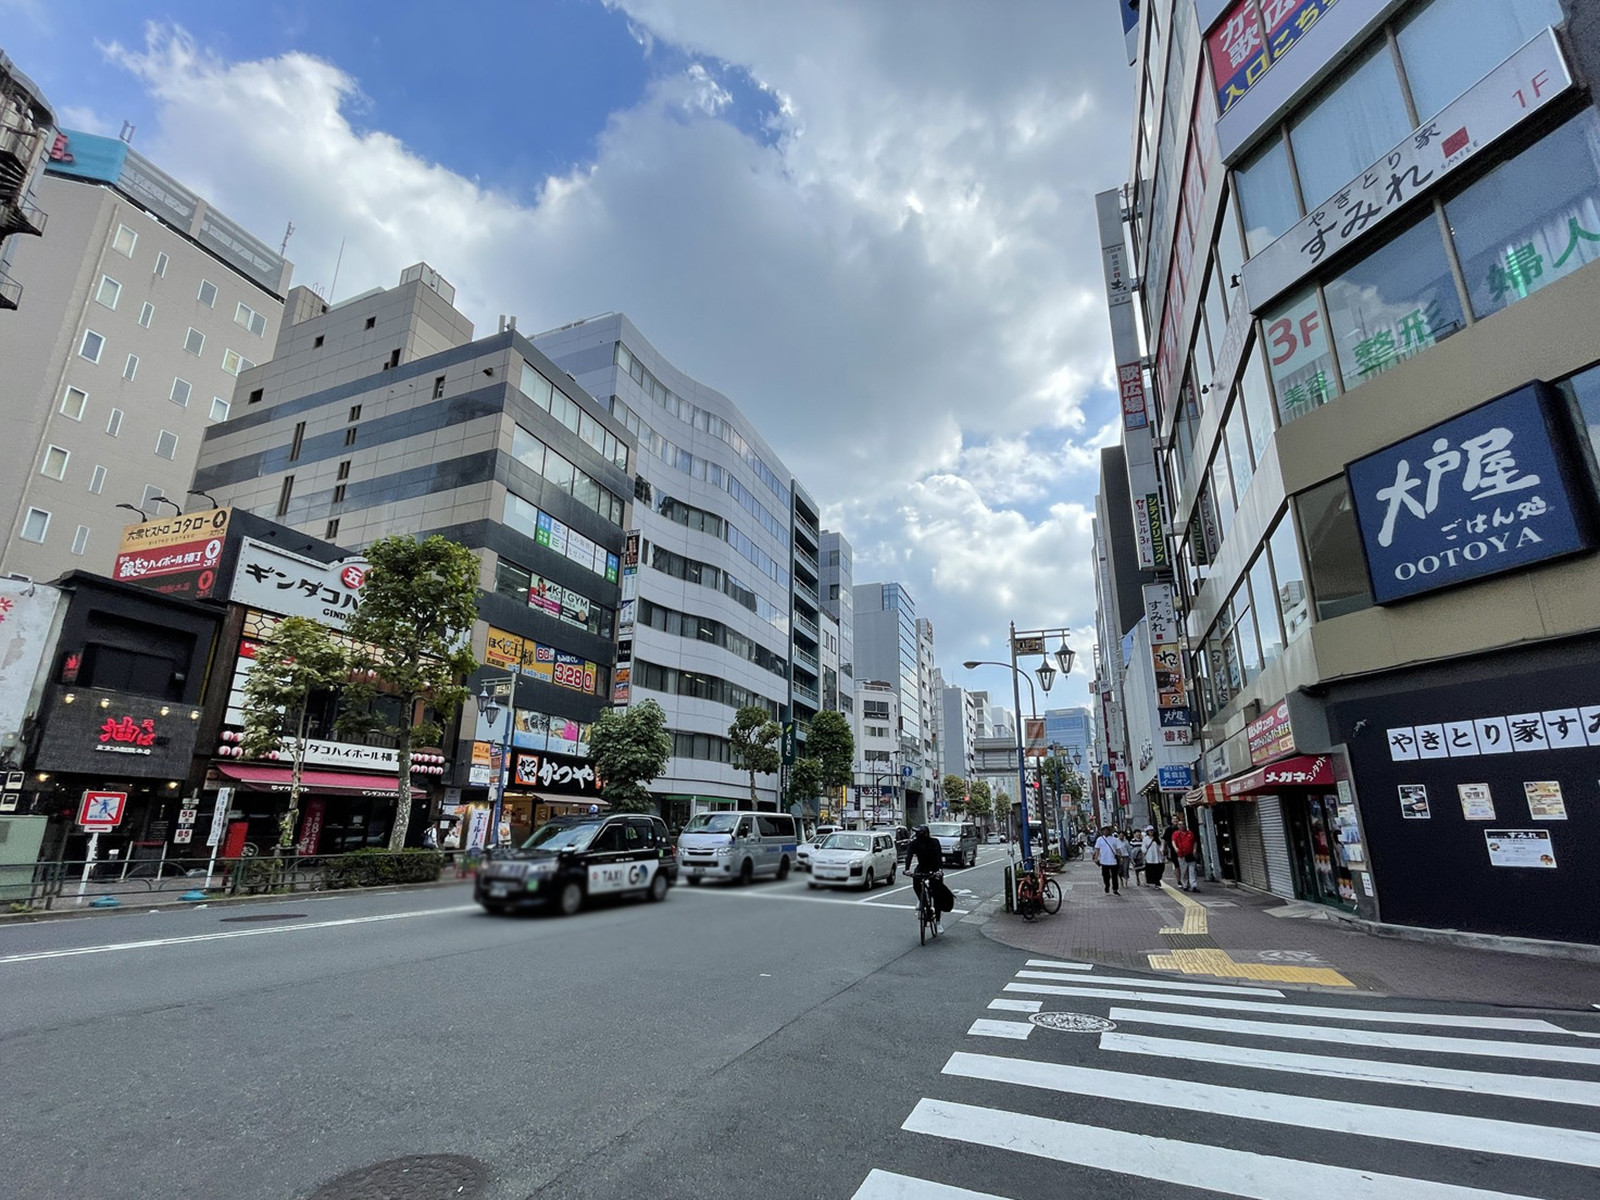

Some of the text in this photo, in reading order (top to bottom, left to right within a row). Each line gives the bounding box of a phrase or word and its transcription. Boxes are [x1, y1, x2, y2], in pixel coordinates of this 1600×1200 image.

[1223, 0, 1335, 112] 入口こち
[1512, 69, 1550, 108] 1F
[1307, 122, 1442, 228] やきとり家
[1300, 163, 1434, 265] すみれ
[1267, 310, 1320, 367] 3F
[1119, 365, 1144, 413] 歌広場
[1376, 427, 1540, 547] 大戸屋
[127, 516, 211, 541] 大衆ビストロ コタロー
[1148, 497, 1164, 563] シティクリニック
[1394, 526, 1543, 581] OOTOYA
[343, 567, 364, 587] 五
[567, 592, 588, 609] GYM
[1148, 600, 1166, 633] すみれ
[488, 636, 534, 666] ほぐし王様
[99, 716, 155, 746] 油そば
[1164, 729, 1188, 742] 歯科
[538, 757, 595, 790] かつや
[1161, 778, 1190, 786] イーオン
[1265, 755, 1327, 783] メガネ コンタクト
[602, 869, 623, 881] TAXI
